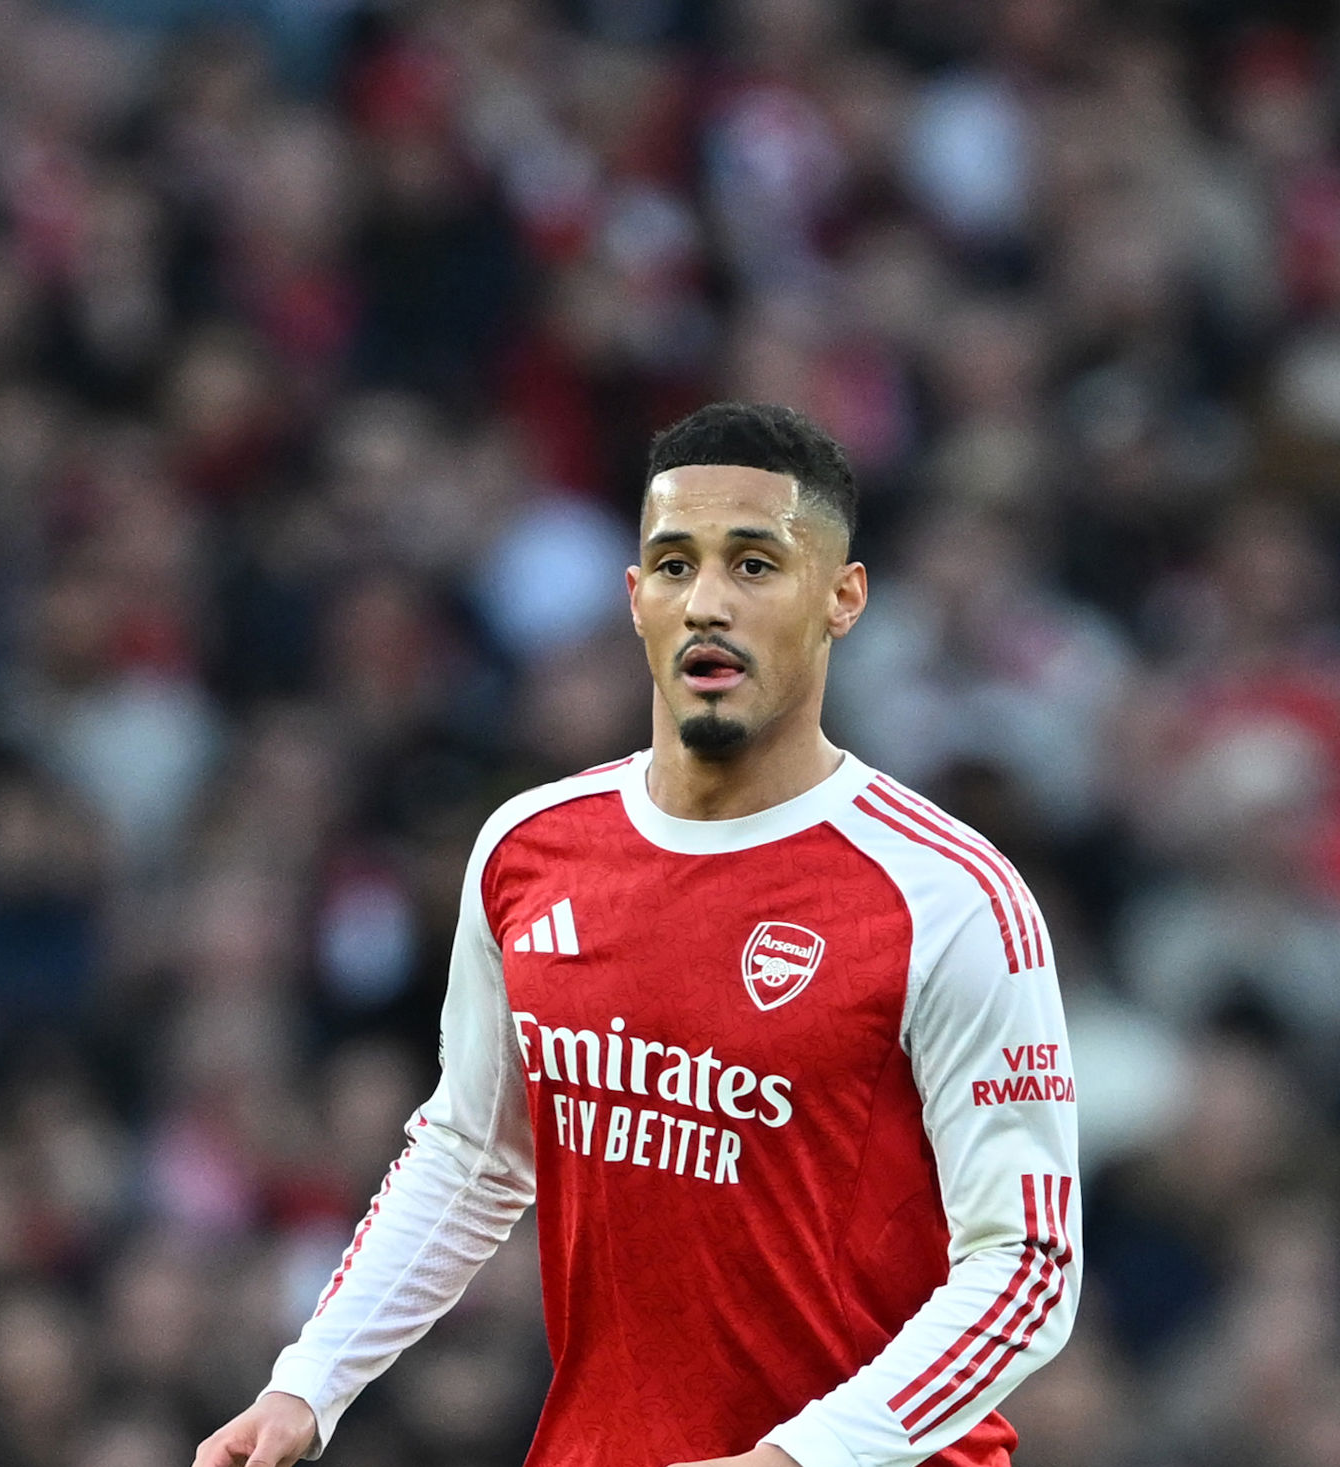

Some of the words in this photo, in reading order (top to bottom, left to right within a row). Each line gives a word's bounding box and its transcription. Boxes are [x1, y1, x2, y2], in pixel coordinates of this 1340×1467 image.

[759, 933, 813, 959] Arsenal
[512, 1011, 793, 1128] Emirates
[972, 1075, 1075, 1106] RWANDA
[553, 1094, 597, 1156] FLY
[604, 1106, 741, 1184] BETTER
